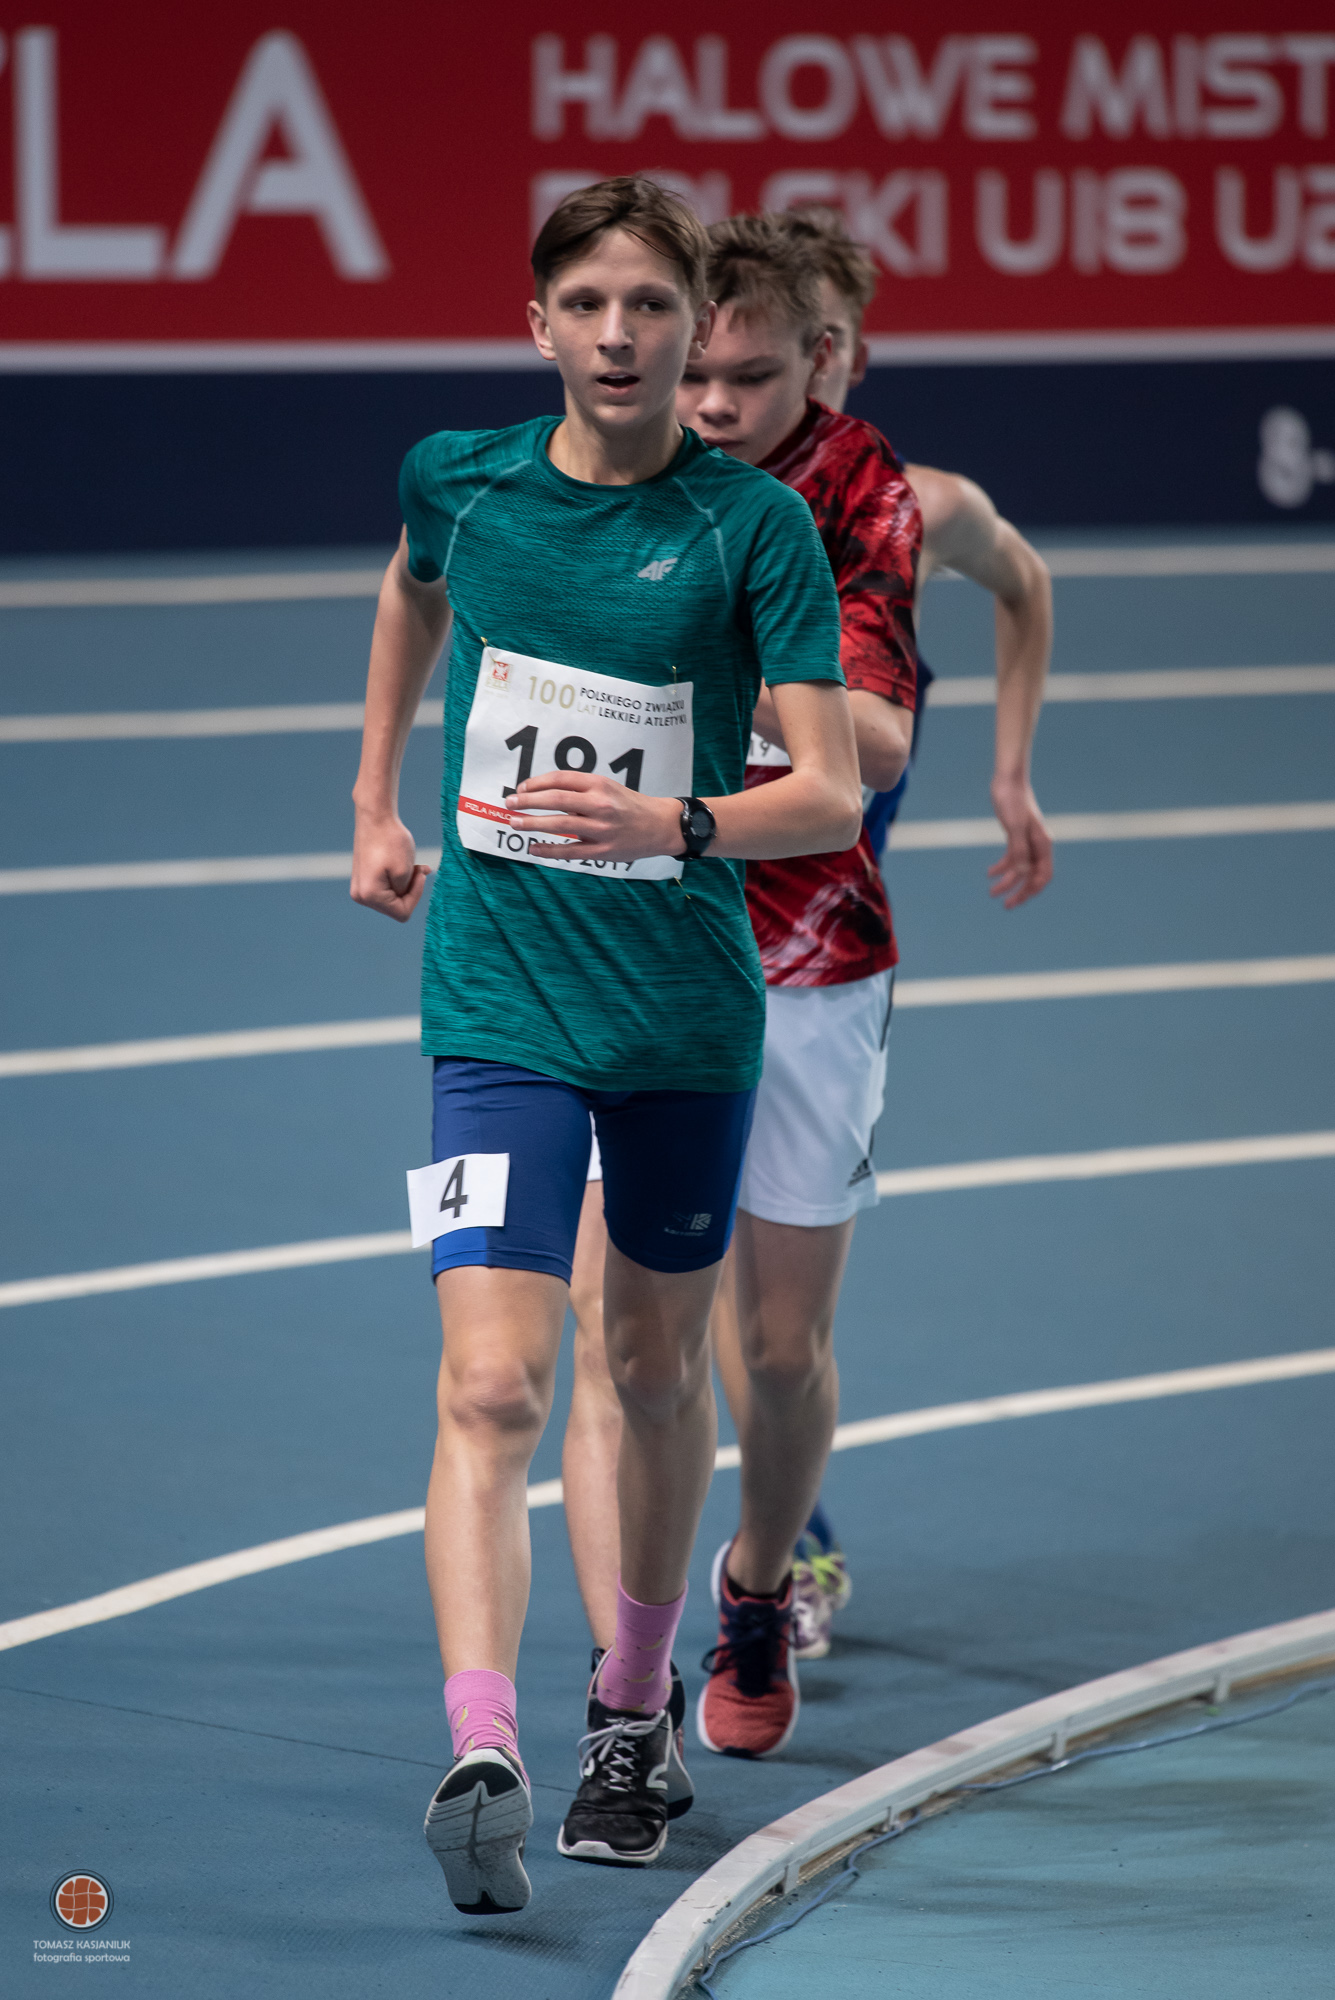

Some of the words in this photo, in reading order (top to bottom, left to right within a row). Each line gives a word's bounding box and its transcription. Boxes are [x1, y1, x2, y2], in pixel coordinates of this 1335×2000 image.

[532, 35, 1037, 141] HALOWE
[1061, 33, 1335, 140] MIST
[0, 27, 390, 280] LA
[975, 169, 1187, 275] U18
[637, 557, 678, 581] 4F
[528, 676, 576, 709] 100
[580, 687, 642, 711] POLSKIEGO
[645, 700, 685, 714] ZWIĄZKU
[577, 704, 597, 716] LAT
[598, 706, 641, 725] LEKKIEJ
[644, 714, 688, 727] ATLETYKI
[440, 1159, 468, 1218] 4
